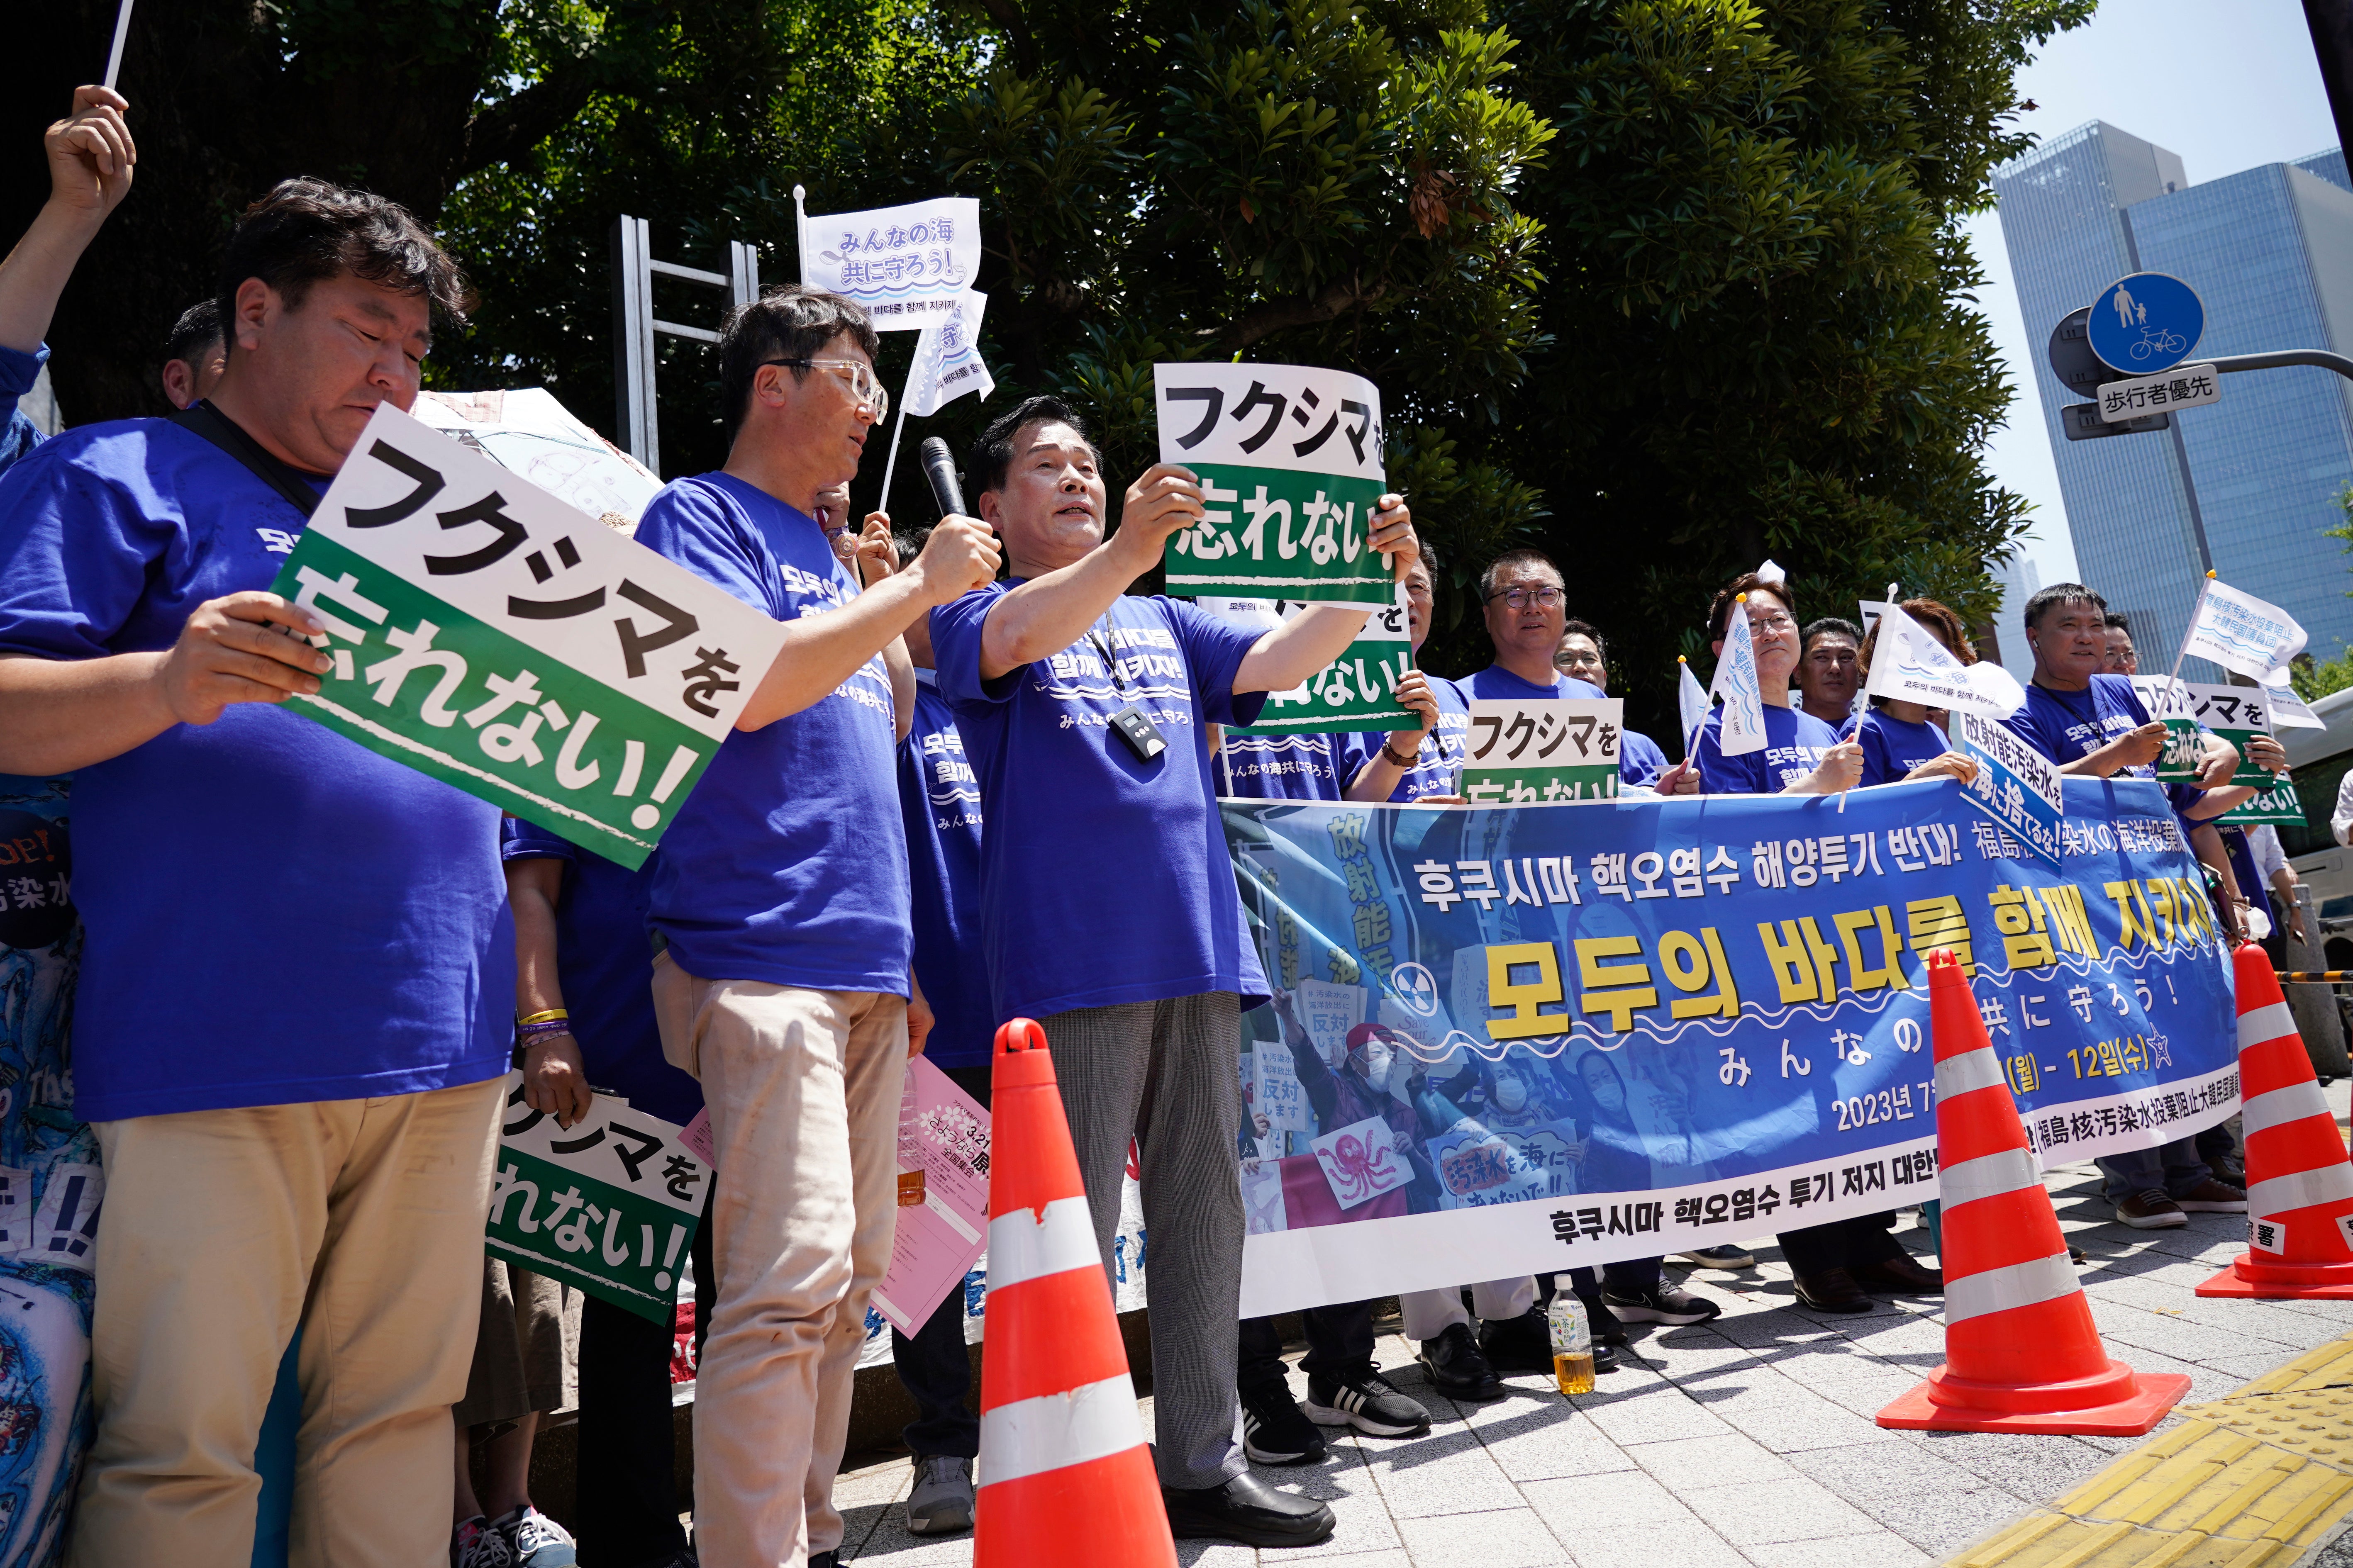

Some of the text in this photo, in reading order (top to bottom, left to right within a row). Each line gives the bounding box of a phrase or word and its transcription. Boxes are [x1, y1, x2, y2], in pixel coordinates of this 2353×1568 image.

[840, 218, 953, 253] みんなの海
[842, 250, 951, 284] 共に守ろう!
[874, 303, 903, 315] 바다를
[906, 301, 926, 313] 함께
[929, 299, 956, 311] 지키자!
[943, 367, 969, 385] 바다를
[2104, 375, 2213, 414] 歩行者優先
[1165, 380, 1385, 470] フクシマを
[344, 438, 741, 719] フクシマを
[779, 564, 844, 608] 모두의
[1228, 602, 1256, 611] 모두의
[2212, 613, 2277, 649] 大韓民国議員団
[1050, 654, 1104, 679] 함께
[290, 564, 700, 830] 忘れない!
[1903, 680, 1928, 691] 모두의
[1930, 684, 1955, 696] 바다를
[1957, 690, 1973, 700] 함께
[1473, 711, 1617, 761] フクシマを
[1765, 746, 1814, 767] 모두의
[1963, 712, 2061, 809] 放射能汚染水を
[1967, 751, 2060, 858] 海に捨てるな!
[1413, 855, 1581, 912] 후쿠시마
[1590, 846, 1741, 903] 핵오염수
[1751, 831, 1886, 890] 해양투기
[1889, 823, 1962, 872] 반대!
[1485, 926, 1740, 1040] 모두의
[1756, 895, 1976, 1004] 바다를
[1988, 884, 2102, 969] 함께
[1308, 1001, 1351, 1010] 海洋放出に
[1312, 1013, 1349, 1033] 反対
[1397, 1015, 1430, 1030] Save
[1263, 1078, 1300, 1102] 反対
[1831, 1084, 1914, 1131] 2023년
[2067, 1033, 2149, 1079] 12일(수)
[1264, 1104, 1299, 1120] します
[941, 1147, 975, 1179] 全国集会
[1446, 1142, 1565, 1189] 汚染水を海に
[1549, 1200, 1665, 1245] 후쿠시마
[1673, 1183, 1780, 1227] 핵오염수
[1789, 1171, 1834, 1209] 투기
[1842, 1159, 1886, 1198] 저지
[1561, 1318, 1571, 1344] 茶の間
